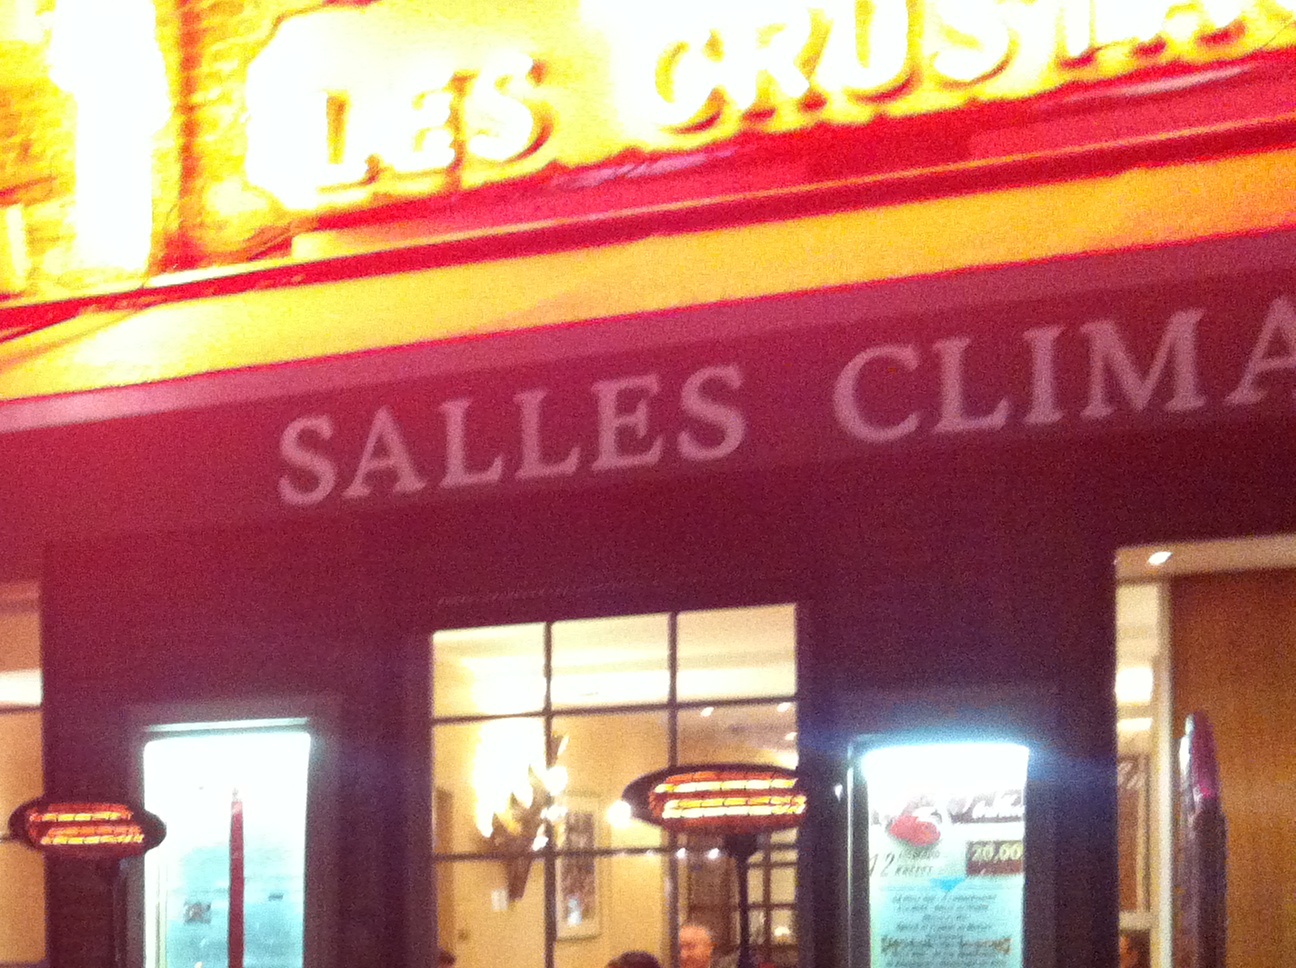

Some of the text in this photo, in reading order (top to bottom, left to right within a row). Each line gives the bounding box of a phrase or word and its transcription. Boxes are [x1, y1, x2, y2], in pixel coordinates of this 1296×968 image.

[302, 50, 544, 190] LES
[277, 295, 1296, 506] SALLES CLIMA
